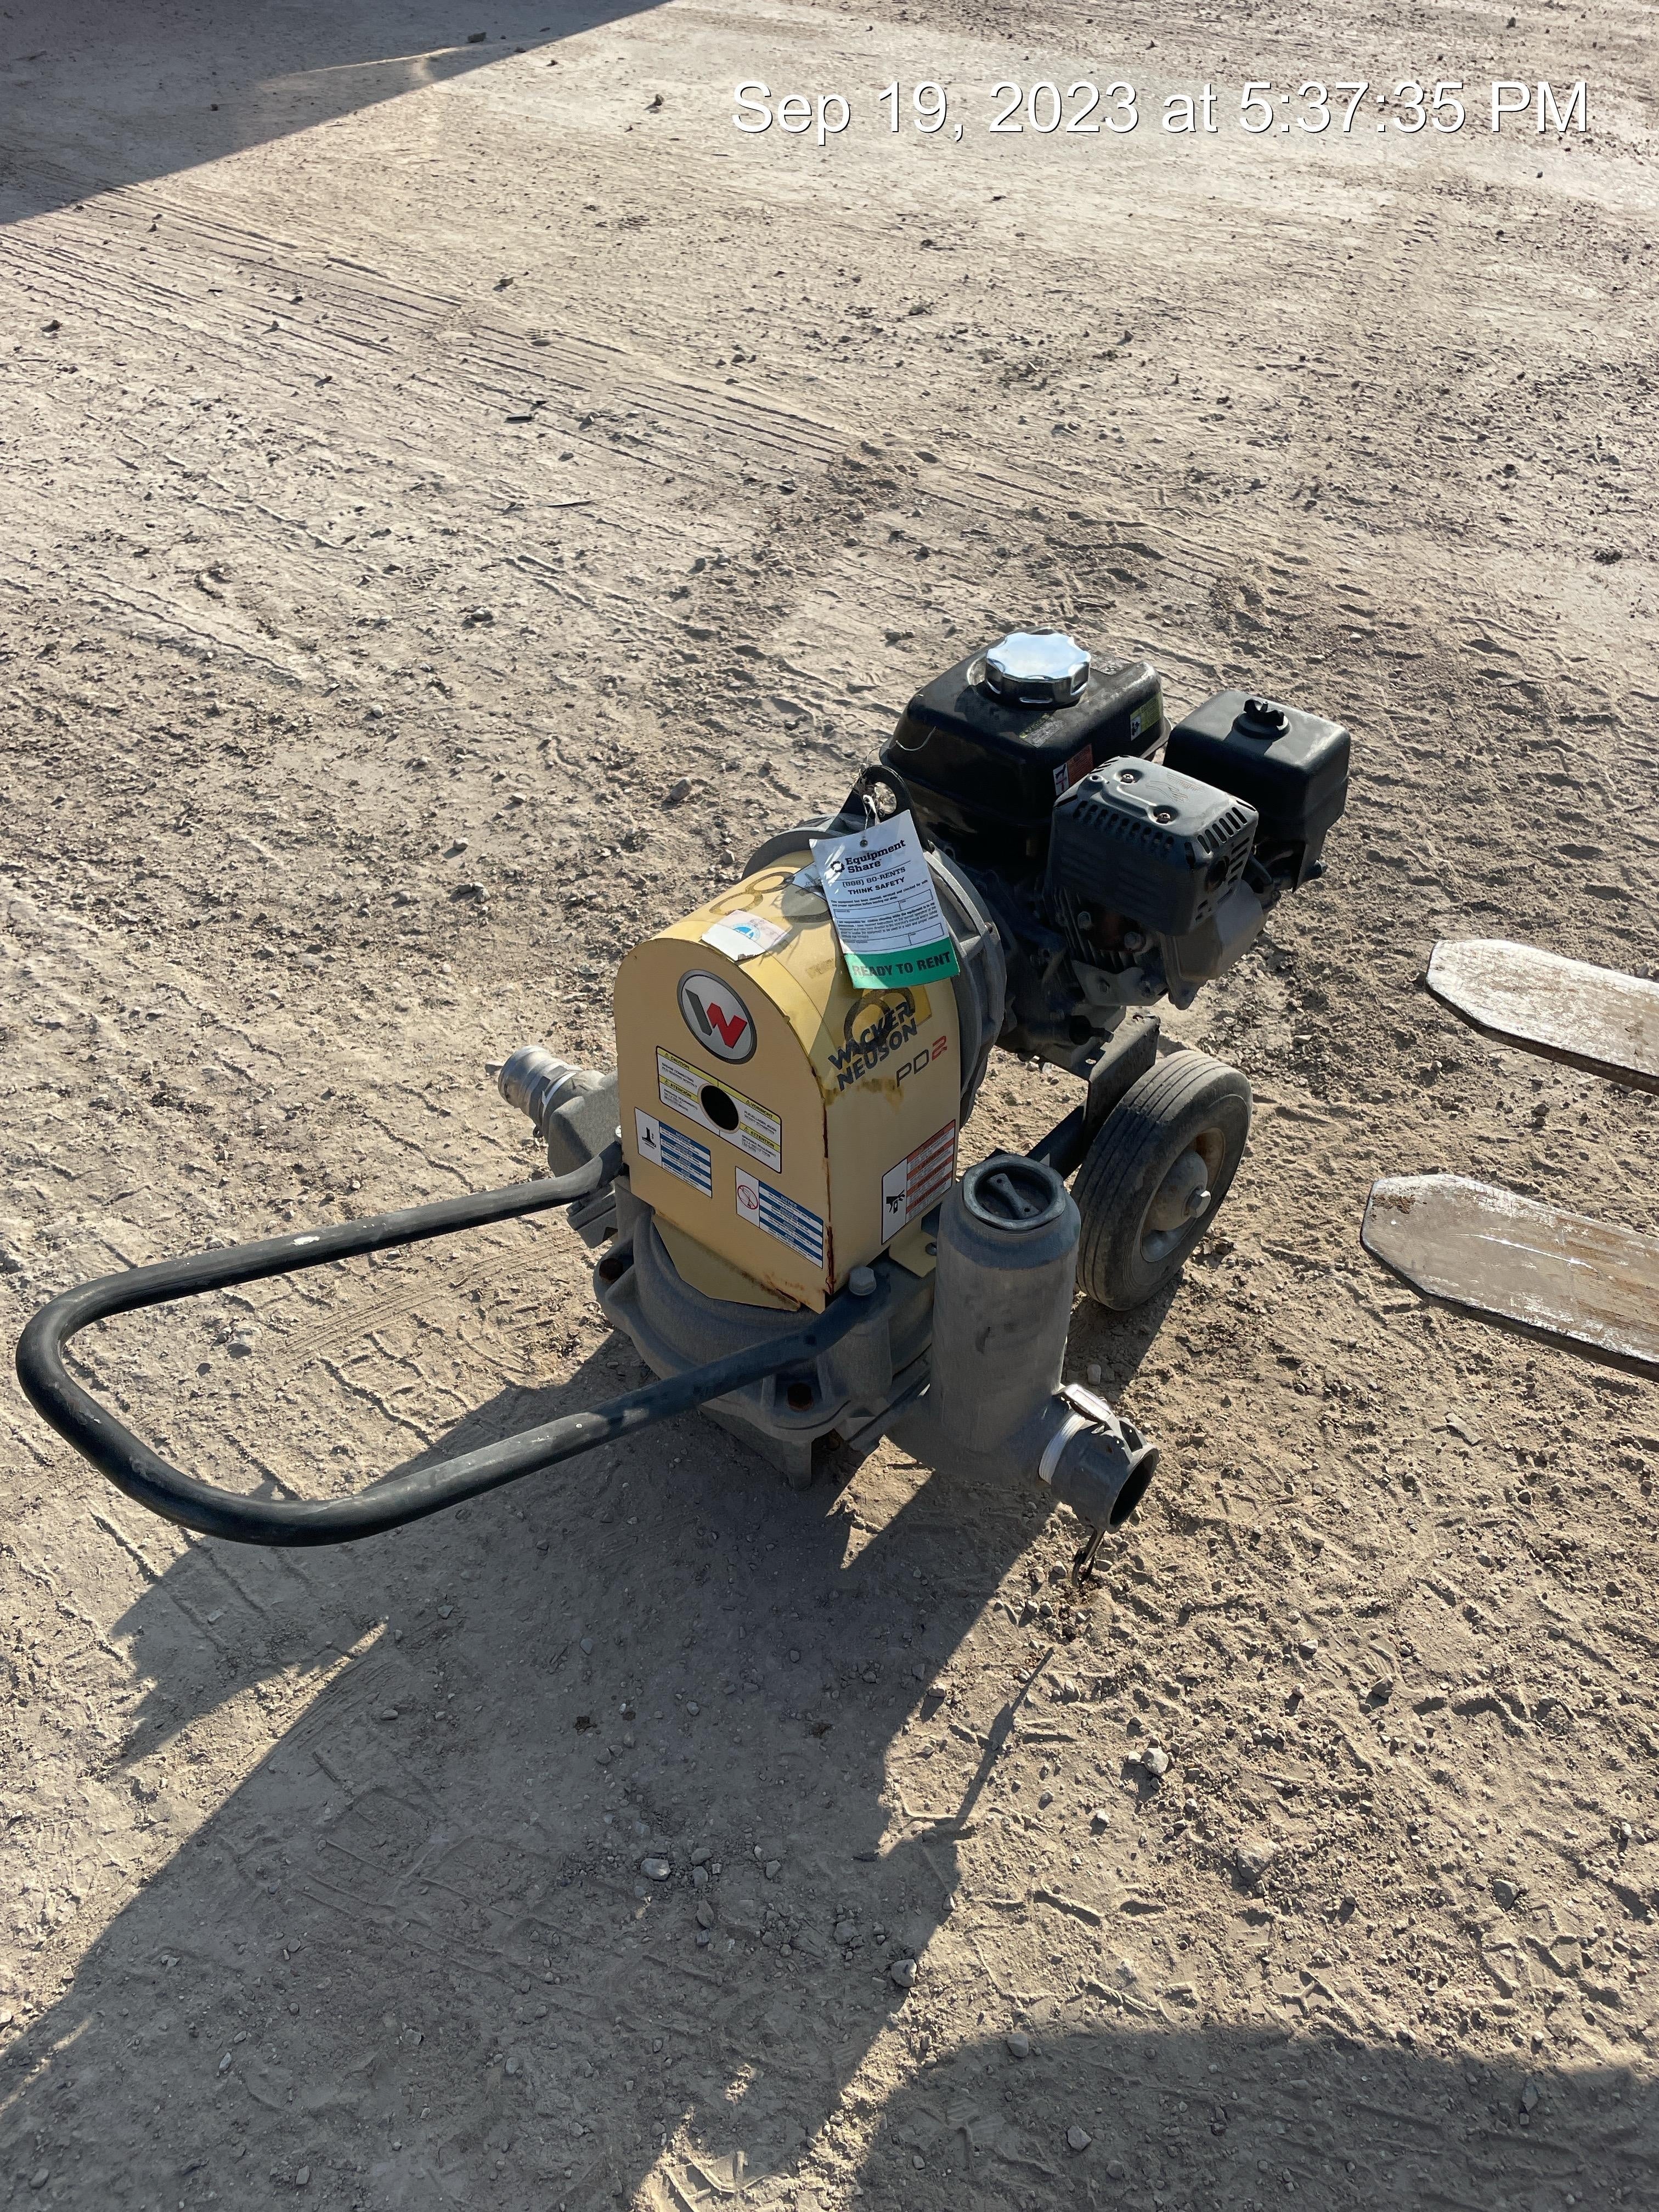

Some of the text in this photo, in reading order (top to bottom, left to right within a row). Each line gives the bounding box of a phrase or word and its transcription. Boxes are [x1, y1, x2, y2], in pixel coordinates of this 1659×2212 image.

[845, 839, 906, 865] Equipment
[847, 860, 881, 873] Share
[848, 876, 905, 895] THINK SAFETY
[852, 951, 951, 977] READY TO RENT
[837, 1017, 918, 1092] NEUSON
[896, 1035, 947, 1088] PD2
